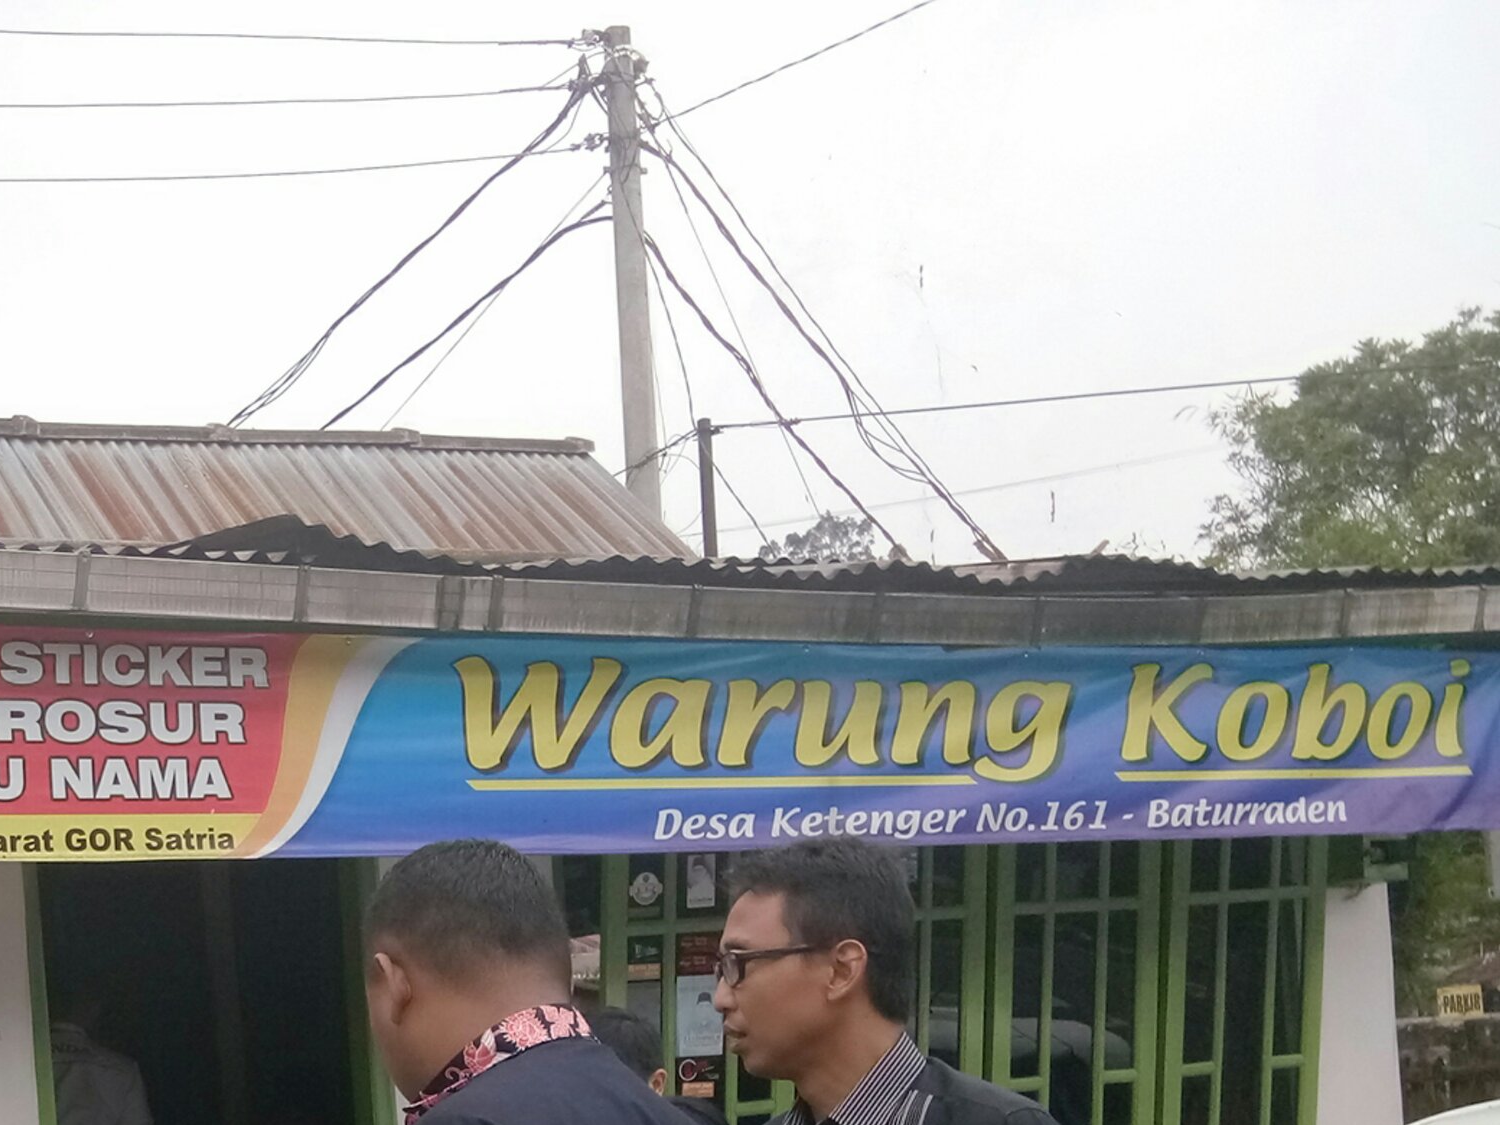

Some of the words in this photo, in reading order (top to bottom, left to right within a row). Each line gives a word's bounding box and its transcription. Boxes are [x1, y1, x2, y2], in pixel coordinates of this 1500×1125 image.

[0, 641, 270, 688] STICKER
[453, 655, 1071, 784] Warung
[1117, 658, 1471, 763] Koboi
[50, 758, 233, 801] NAMA
[64, 829, 133, 852] GOR
[144, 828, 235, 852] Satria
[653, 808, 755, 841] Desa
[770, 805, 966, 842] Ketenger
[976, 800, 1108, 834] No.161
[1146, 797, 1348, 829] Baturraden
